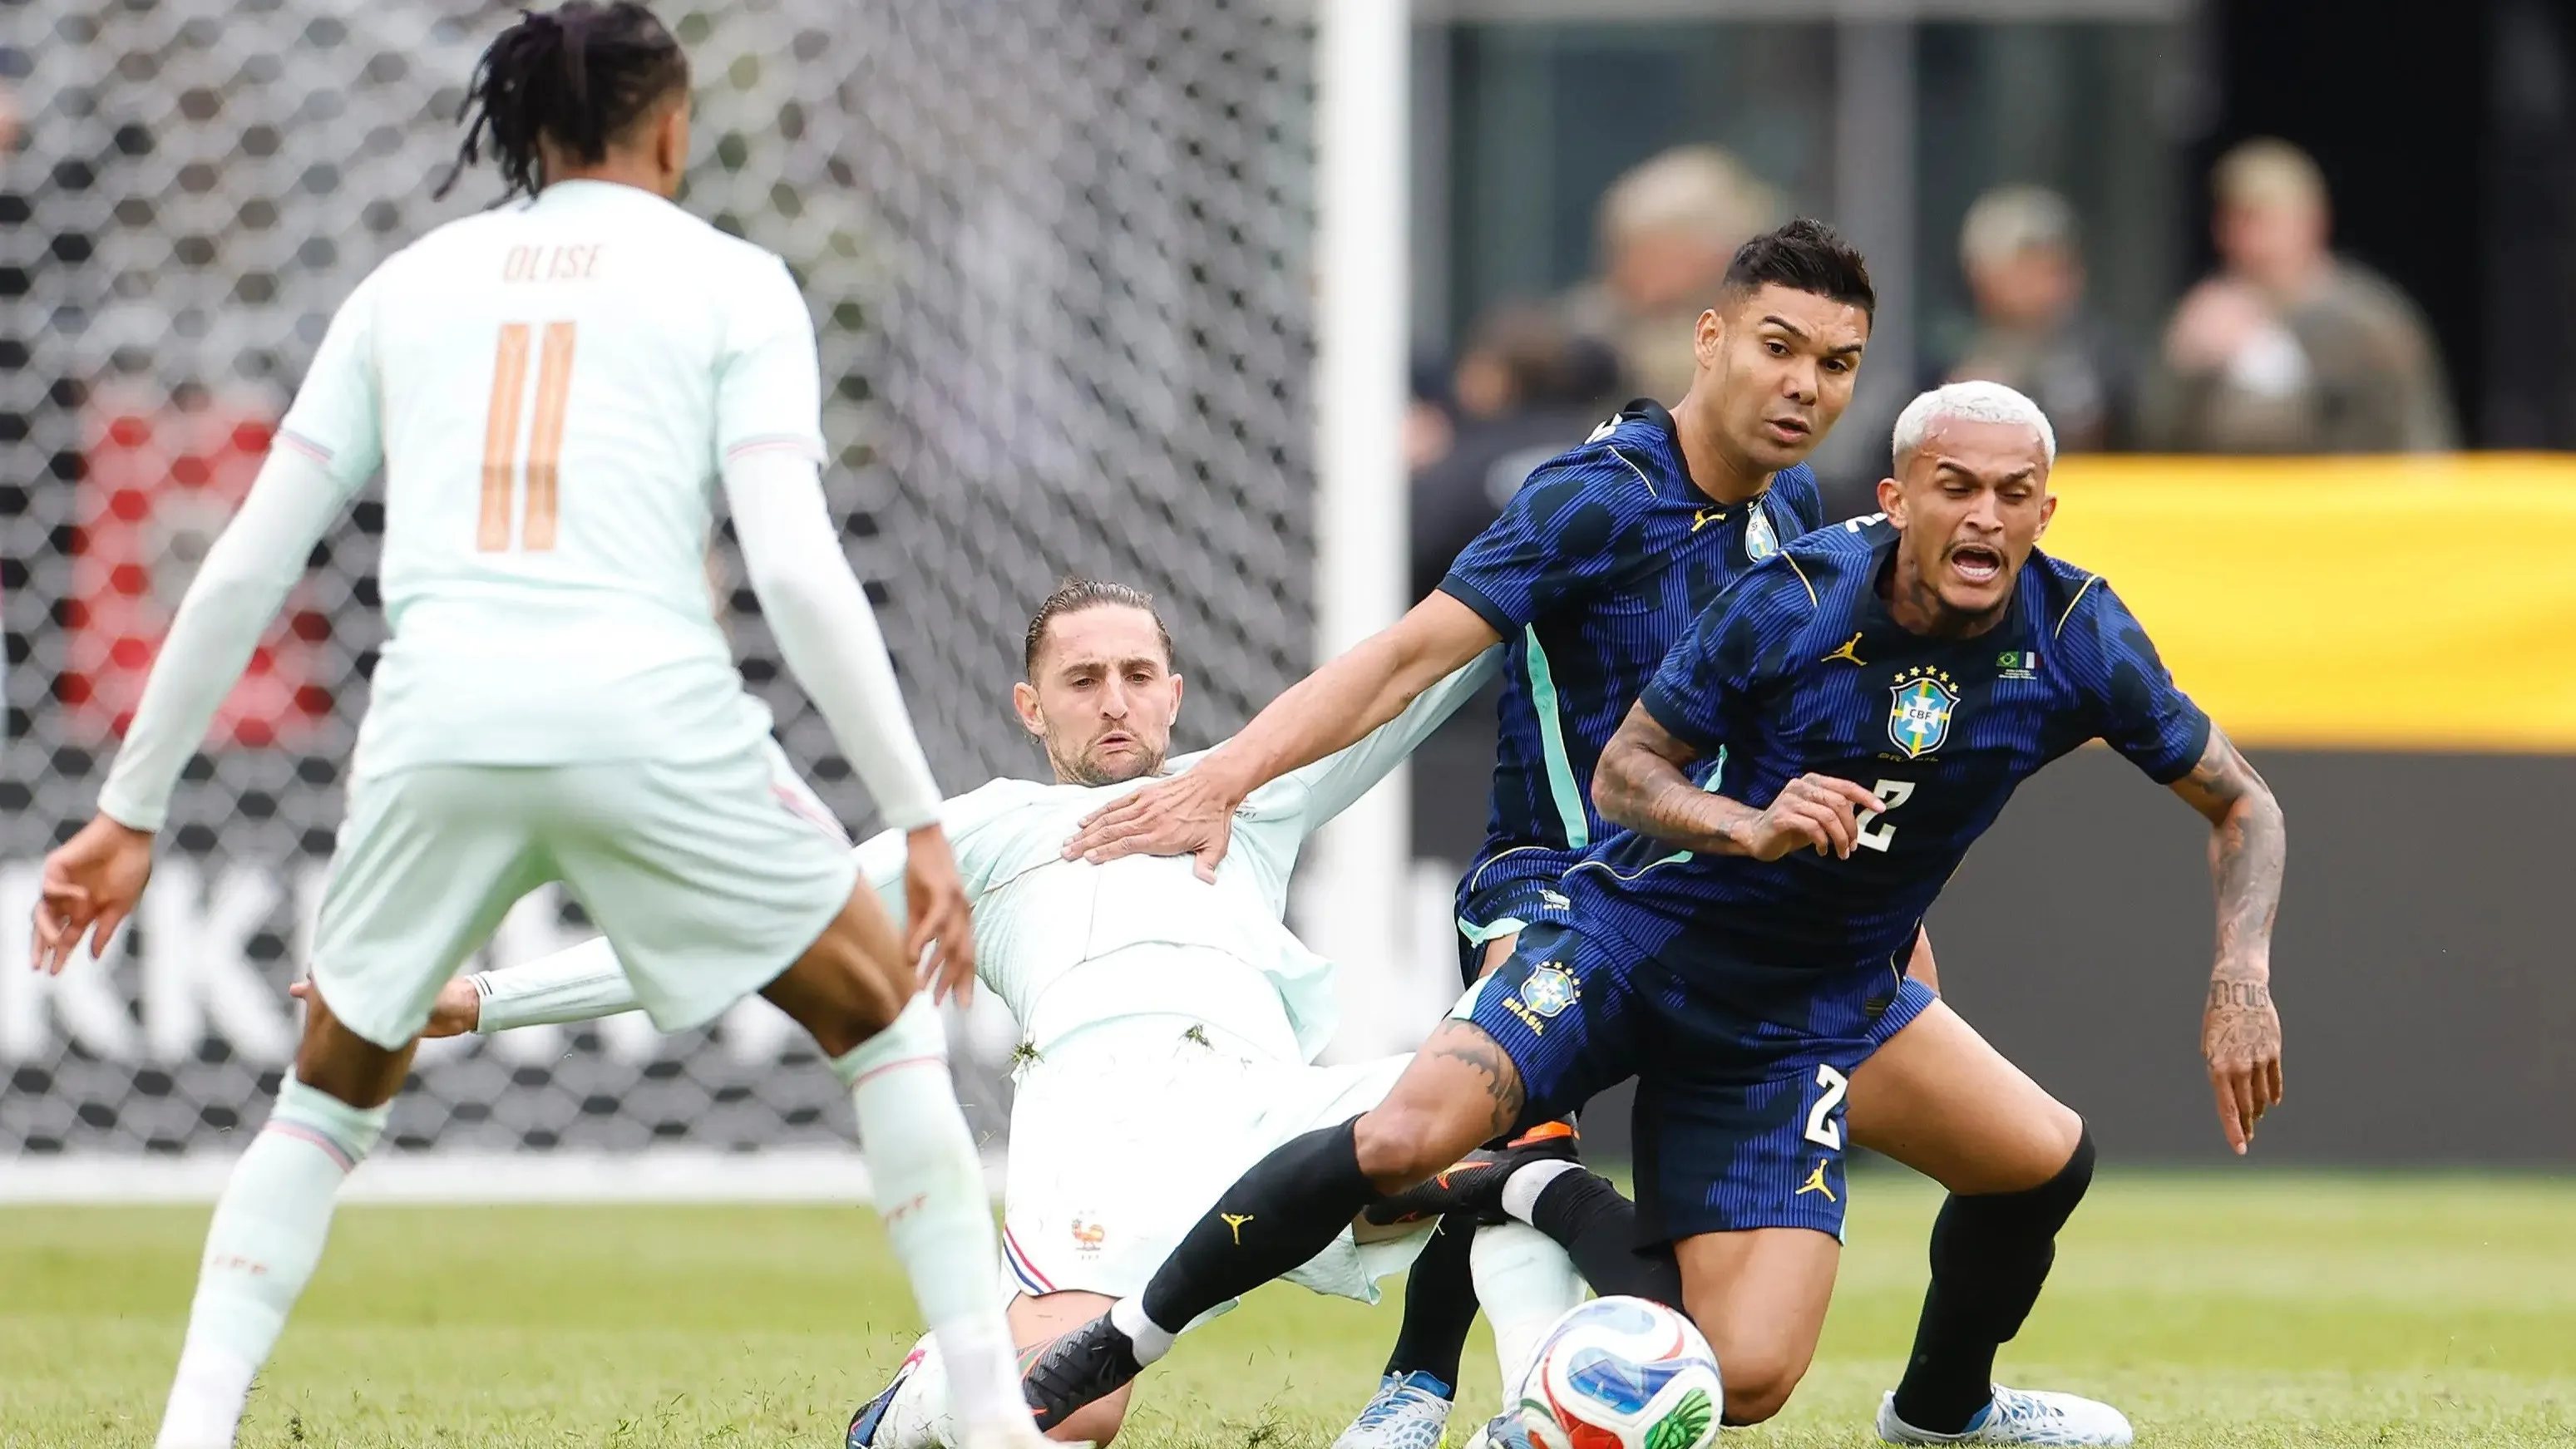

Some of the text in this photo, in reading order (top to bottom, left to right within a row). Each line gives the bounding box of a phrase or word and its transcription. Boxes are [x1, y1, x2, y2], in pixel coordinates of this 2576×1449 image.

[501, 243, 606, 283] OLISE
[476, 320, 578, 554] 11
[1909, 707, 1933, 720] CBF
[1857, 779, 1917, 852] 2
[1502, 997, 1544, 1037] BRASIL
[1804, 1063, 1848, 1151] 2
